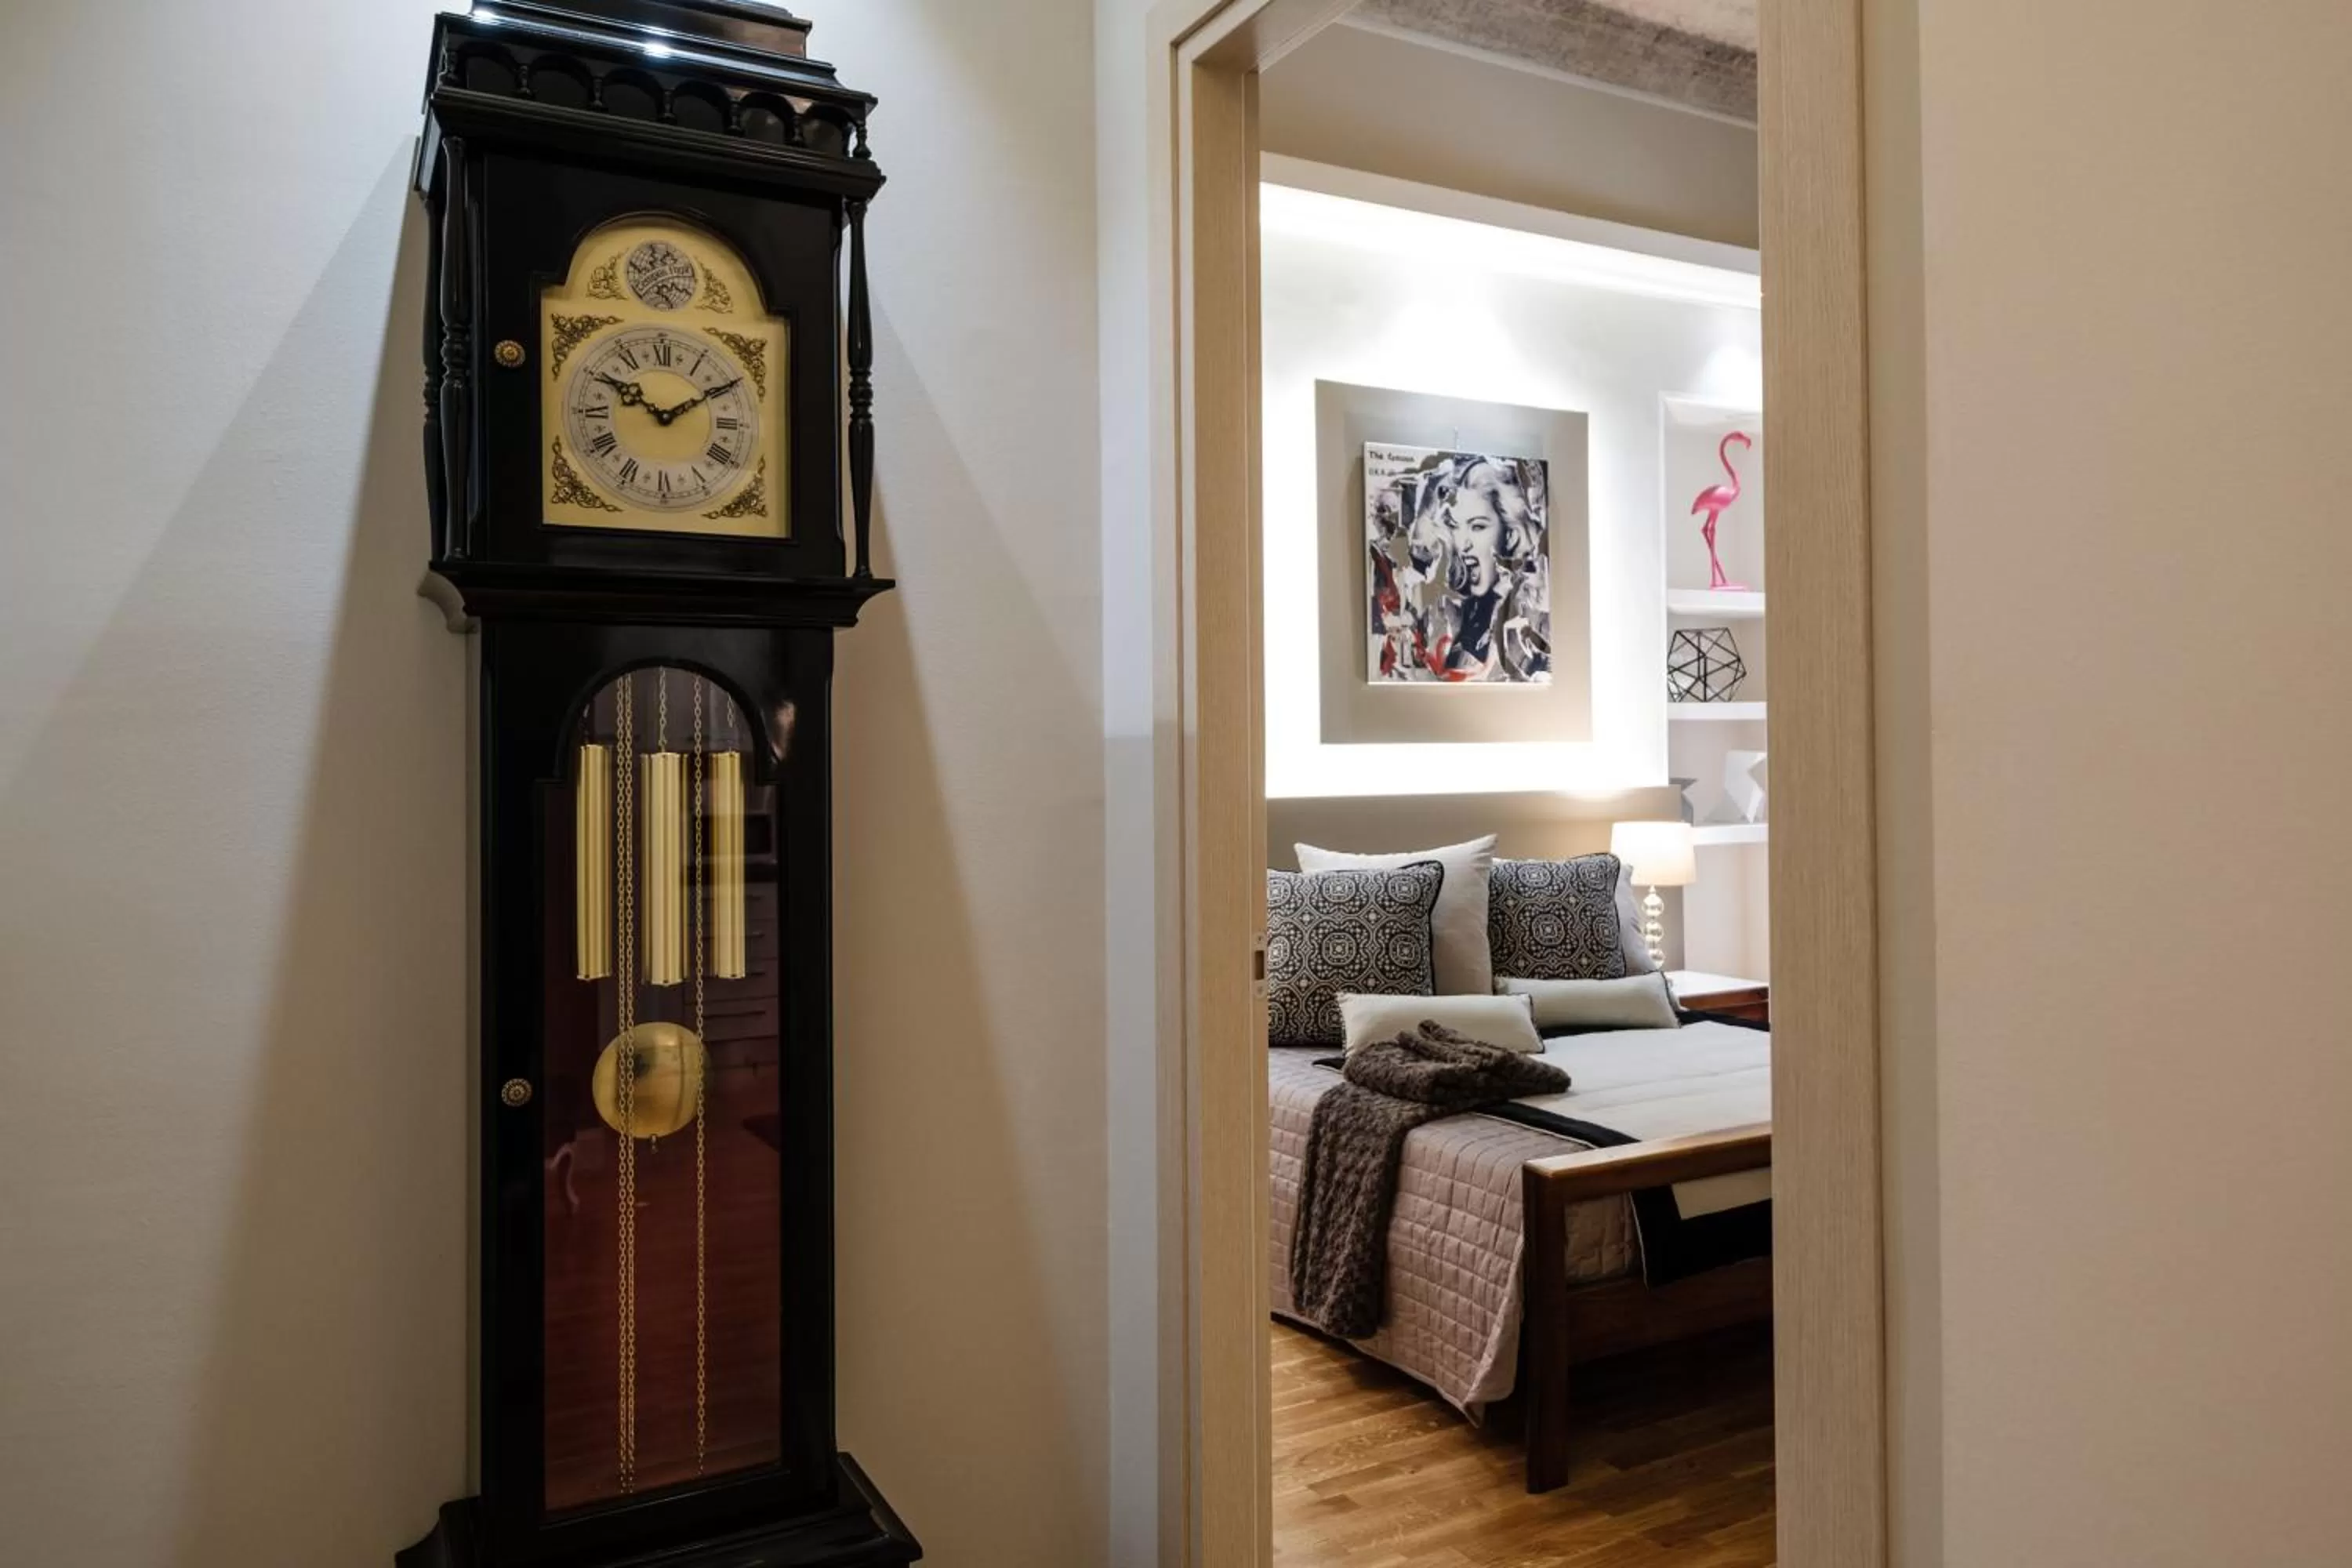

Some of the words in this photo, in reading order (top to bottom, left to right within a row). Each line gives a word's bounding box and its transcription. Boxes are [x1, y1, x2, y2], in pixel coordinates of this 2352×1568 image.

[618, 348, 640, 374] XI
[653, 343, 671, 368] XII
[688, 358, 703, 377] I
[585, 404, 609, 419] IX
[716, 417, 738, 430] III
[592, 432, 617, 458] VIII
[706, 443, 731, 465] IIII
[619, 458, 640, 483] VII
[657, 470, 671, 493] VI
[690, 465, 706, 488] V
